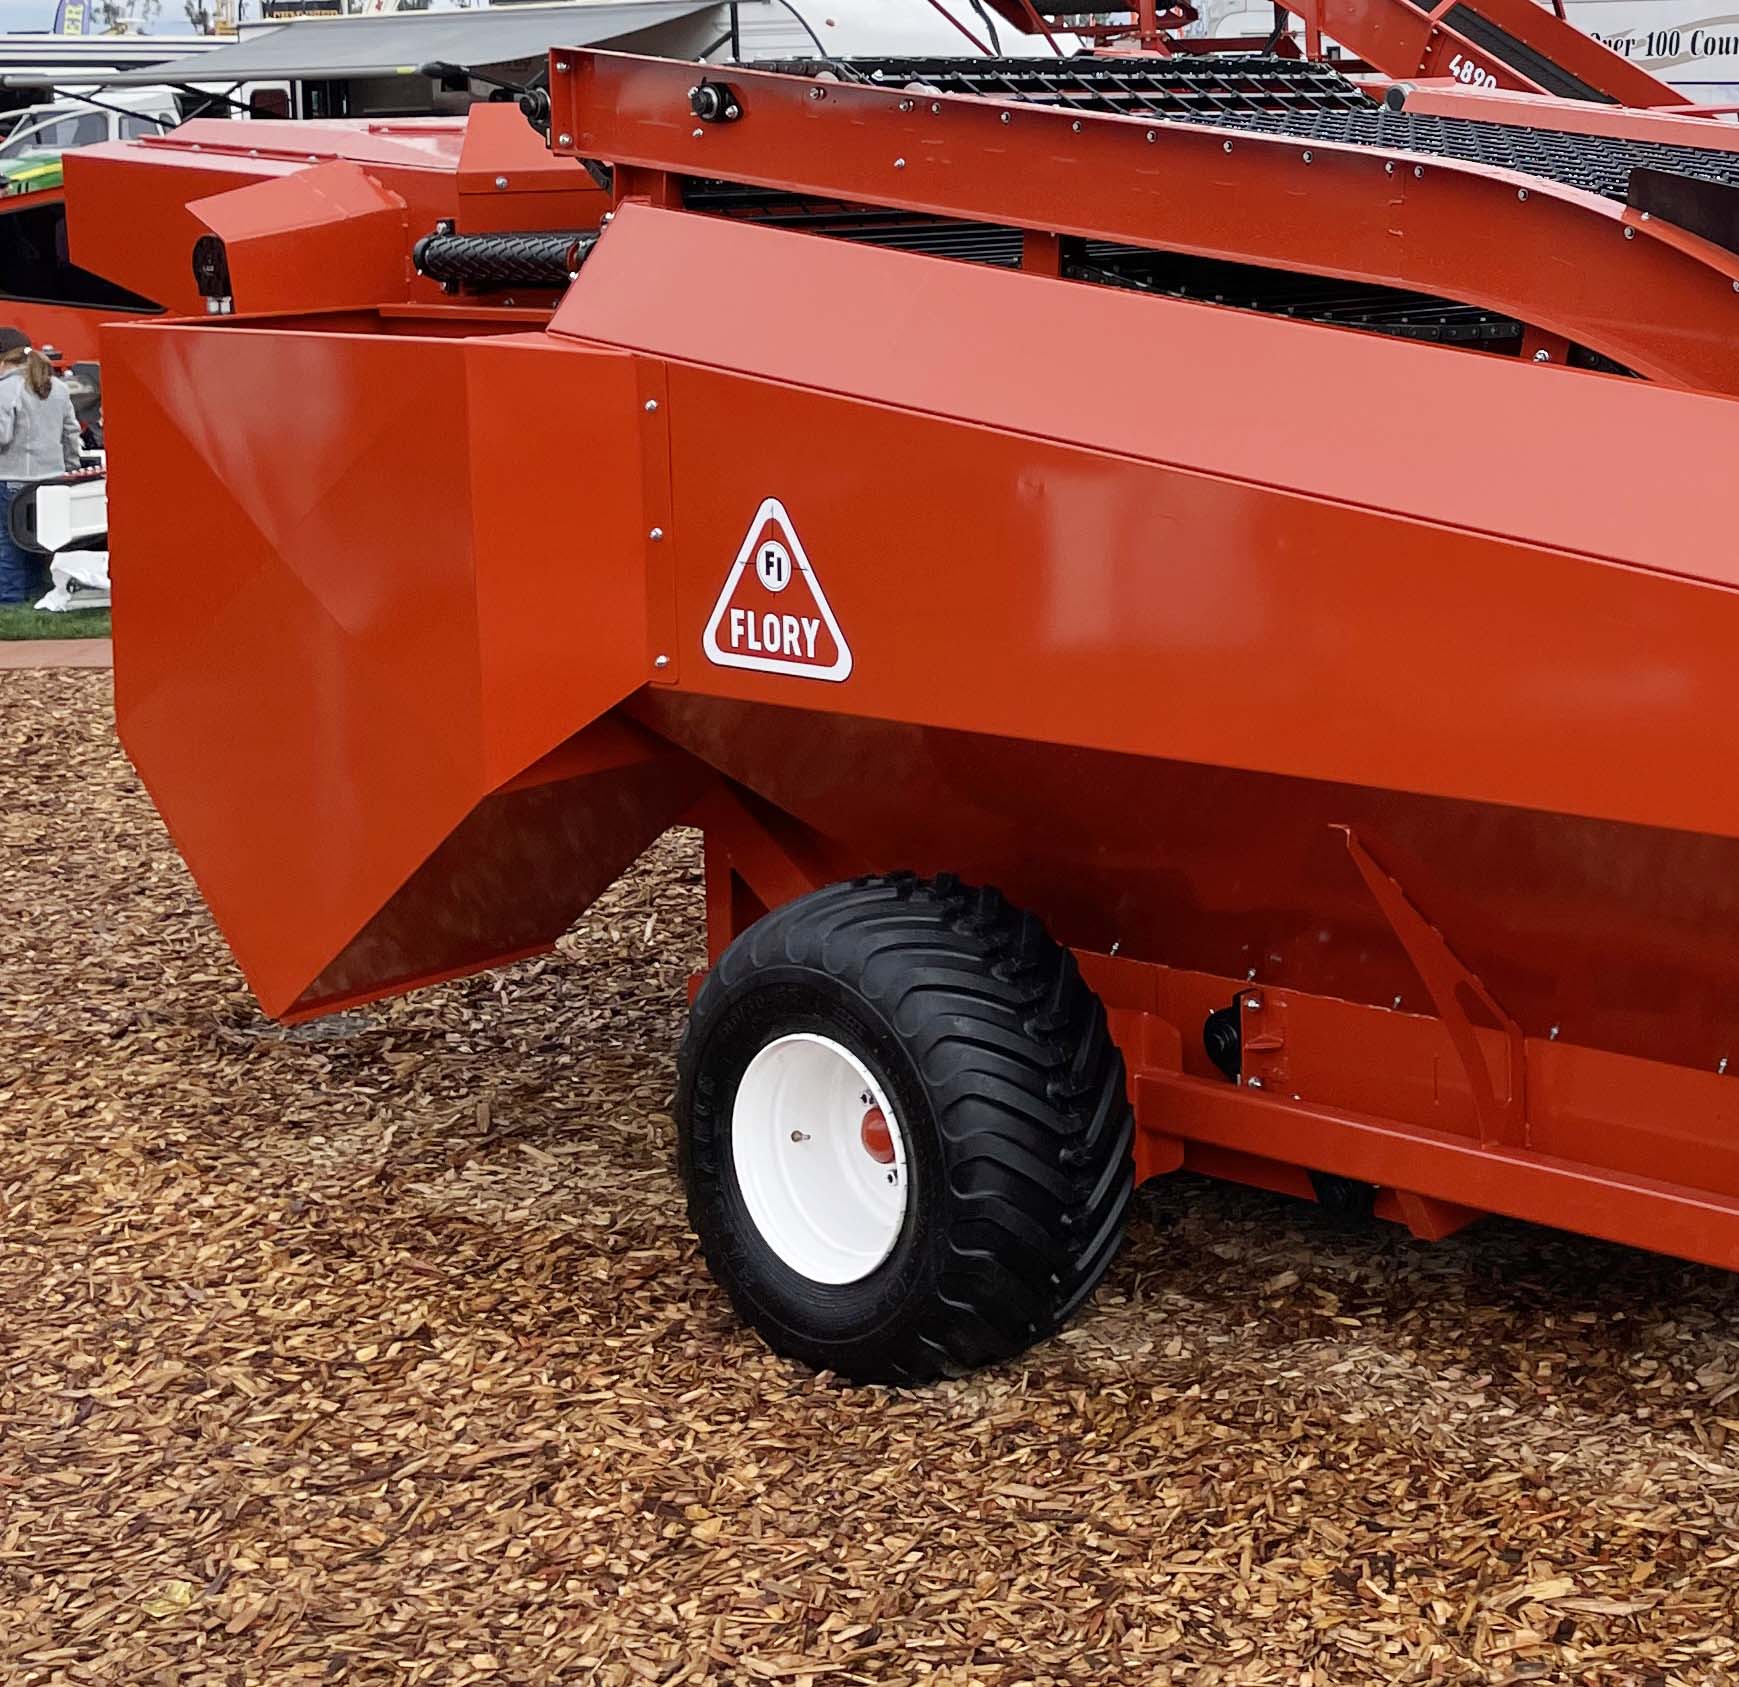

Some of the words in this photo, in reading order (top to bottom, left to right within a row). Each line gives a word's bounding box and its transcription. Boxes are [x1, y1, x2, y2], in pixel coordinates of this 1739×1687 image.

[1590, 32, 1635, 57] er
[1646, 30, 1680, 57] 100
[730, 607, 820, 658] FLORY
